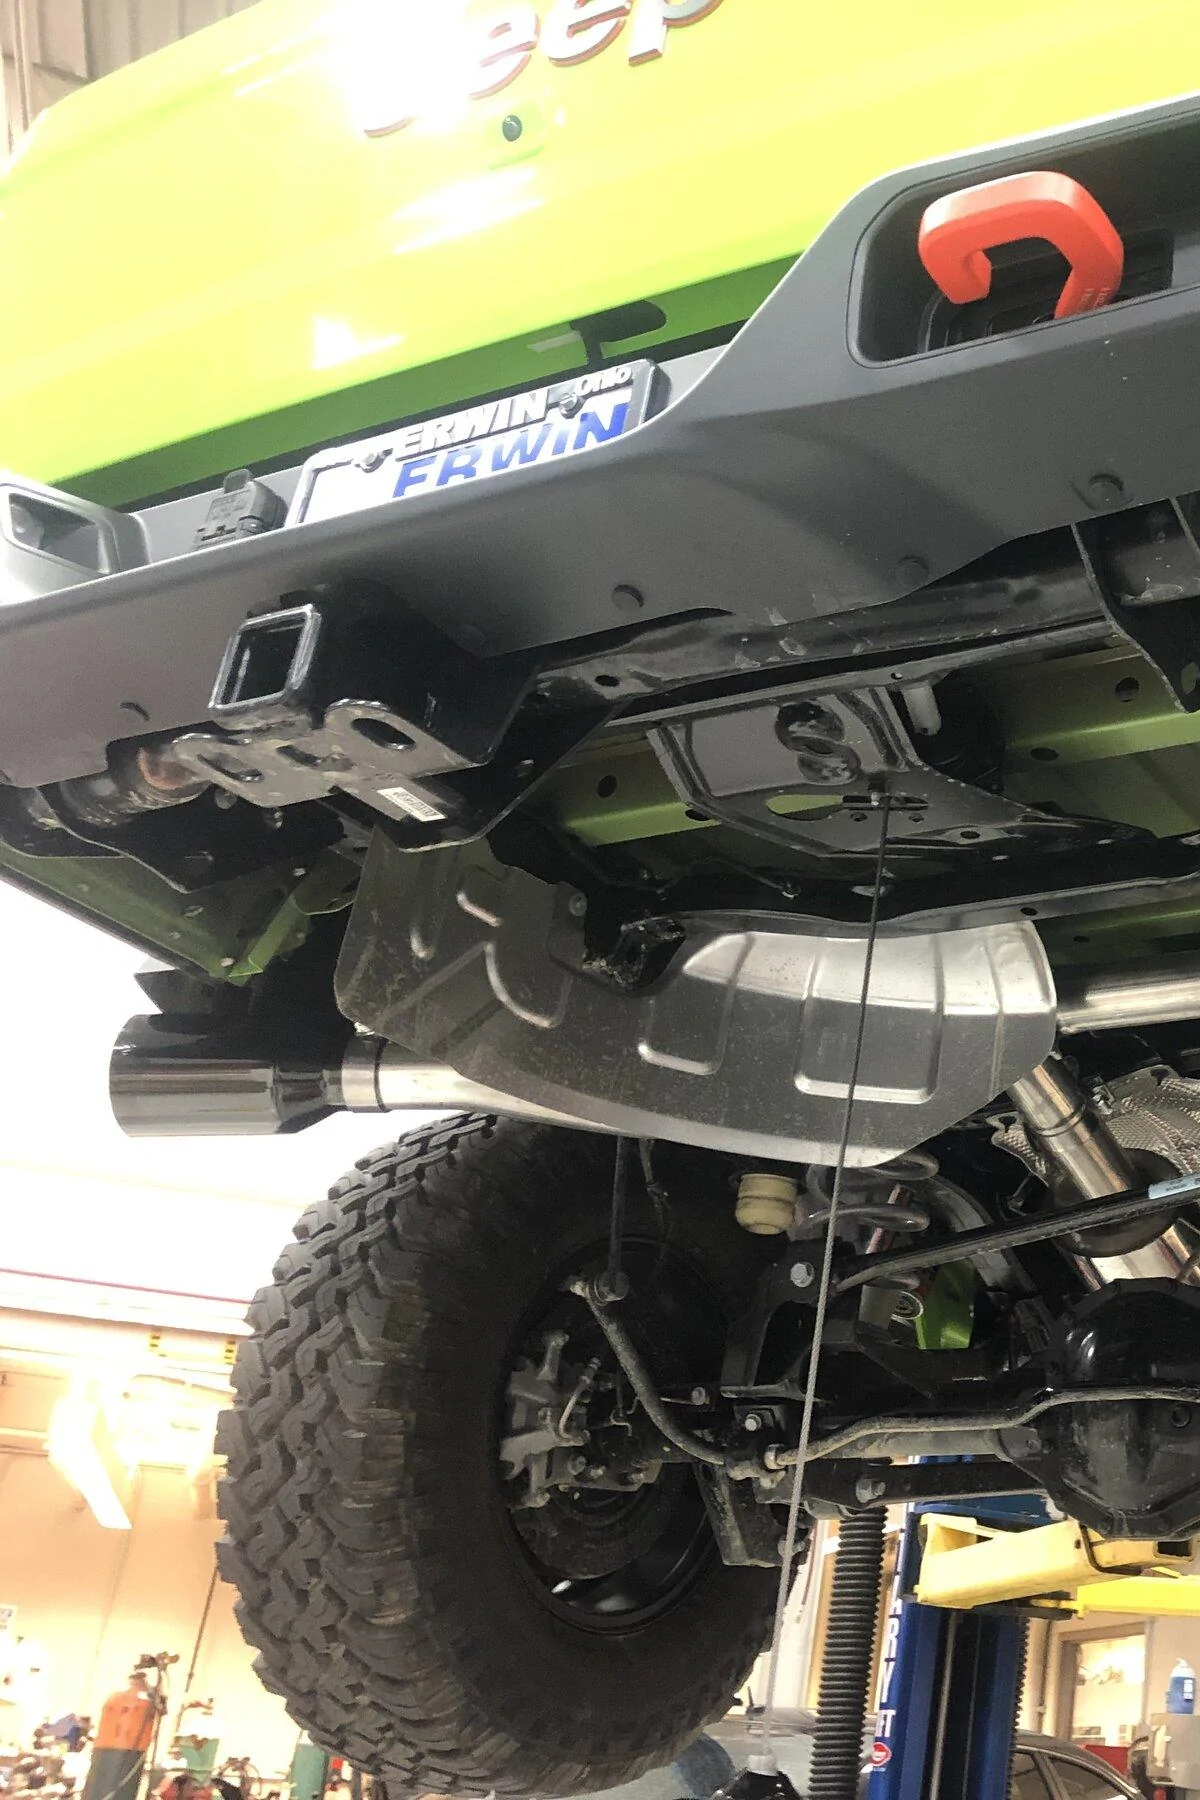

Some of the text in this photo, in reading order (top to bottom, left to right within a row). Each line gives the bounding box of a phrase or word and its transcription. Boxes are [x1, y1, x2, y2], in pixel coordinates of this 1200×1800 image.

[363, 0, 724, 138] eep
[392, 401, 630, 498] ERWIN
[401, 387, 549, 456] ERWIN
